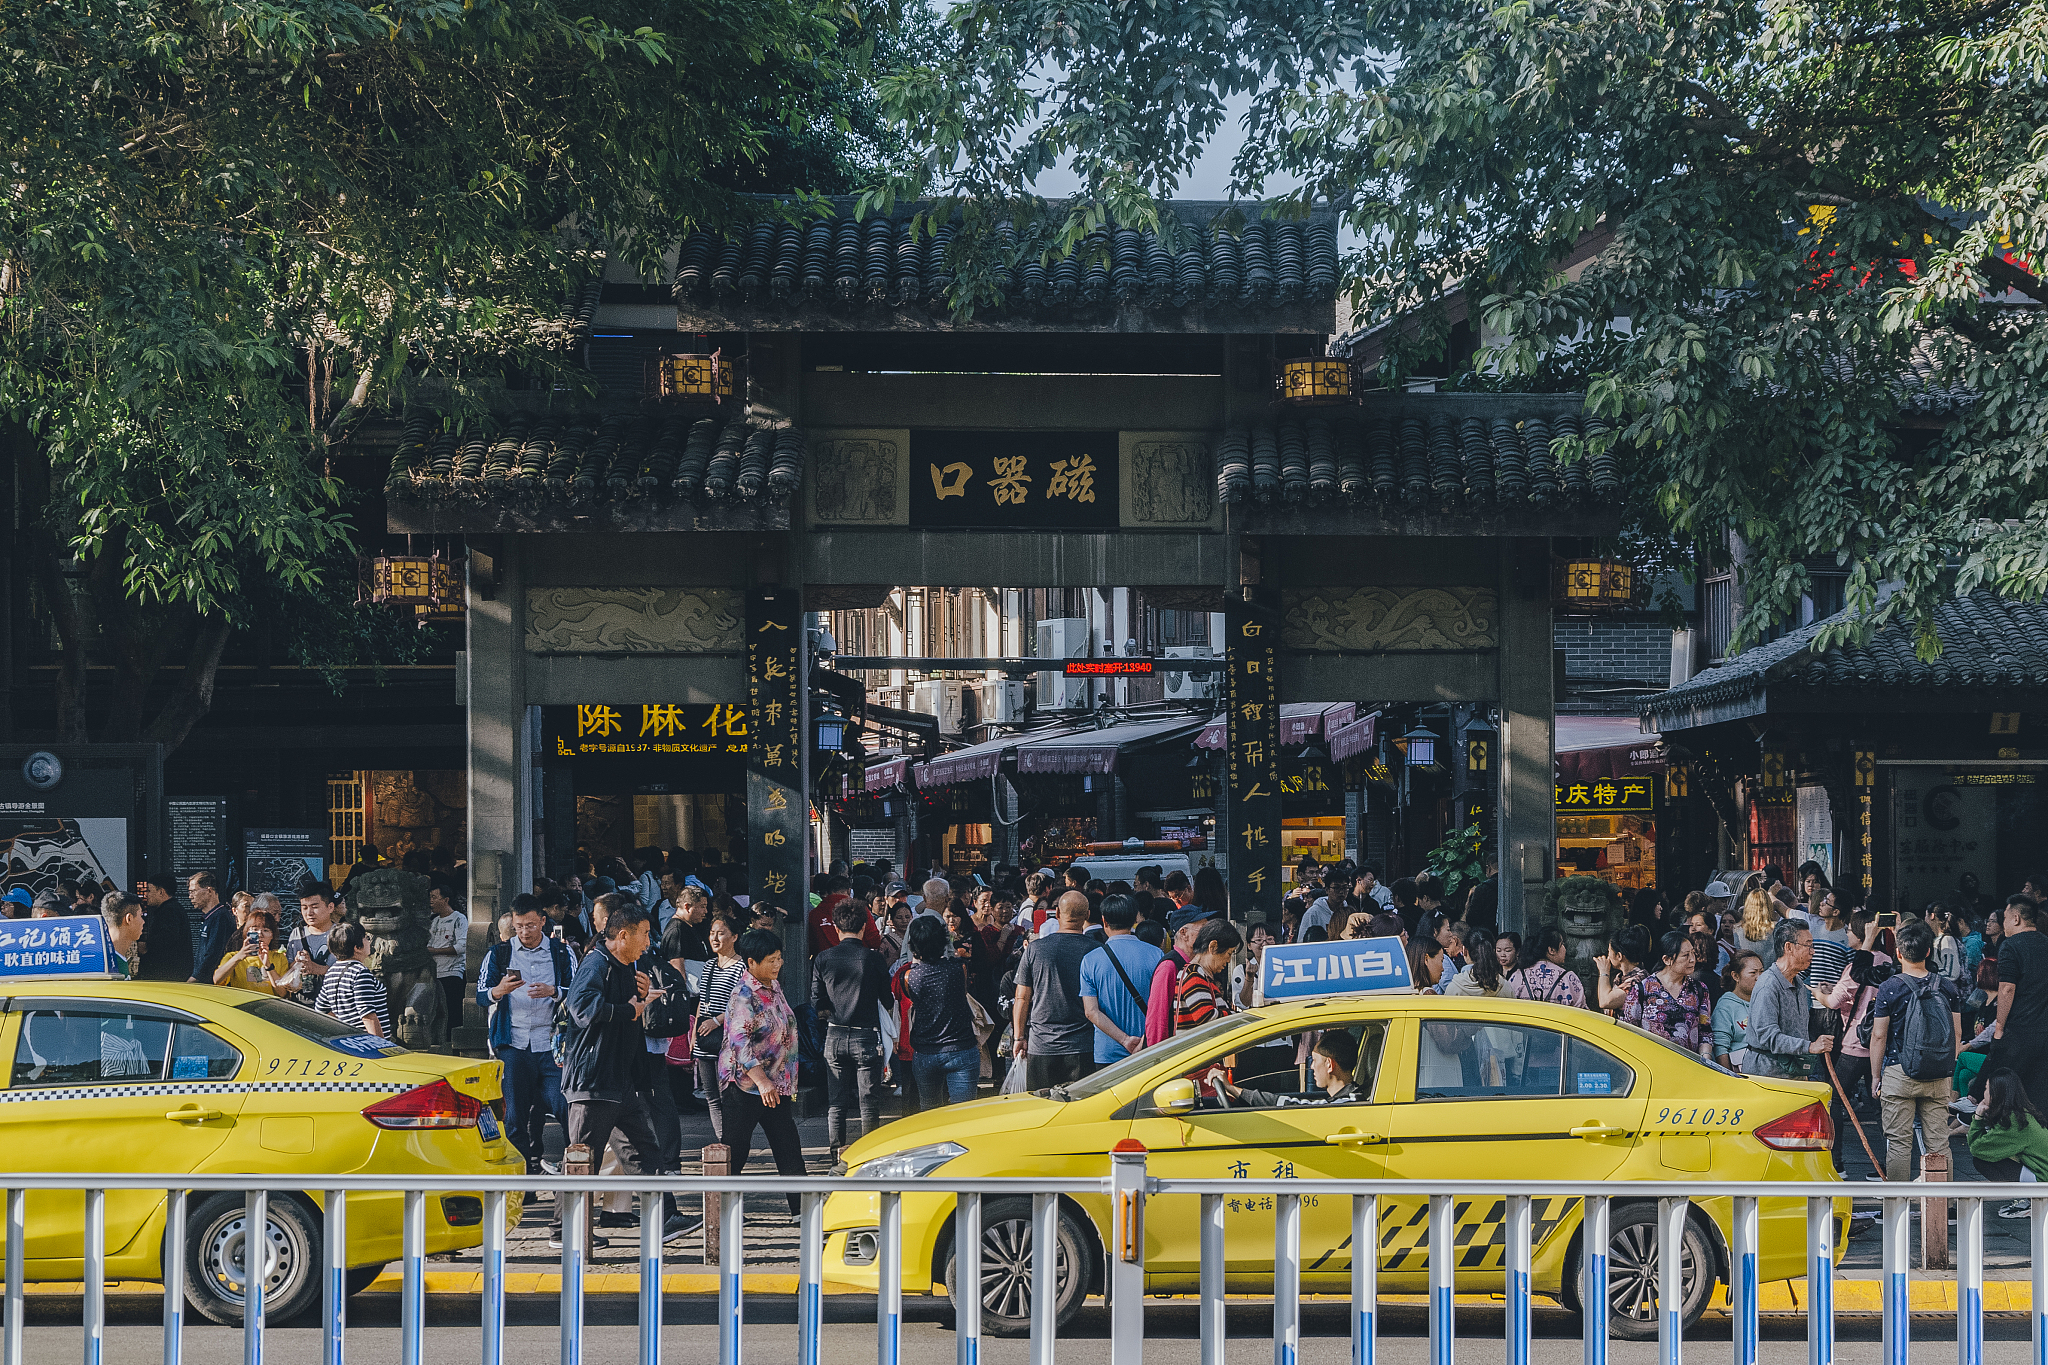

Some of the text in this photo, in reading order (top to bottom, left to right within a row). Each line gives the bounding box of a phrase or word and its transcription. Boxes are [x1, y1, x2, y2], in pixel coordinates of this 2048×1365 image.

[930, 453, 1098, 507] 磁器口
[577, 703, 748, 737] 陈麻花
[4, 949, 81, 968] 耿直的味道
[1271, 951, 1394, 986] 江小白
[265, 1057, 365, 1077] 971282
[1655, 1107, 1745, 1126] 961038
